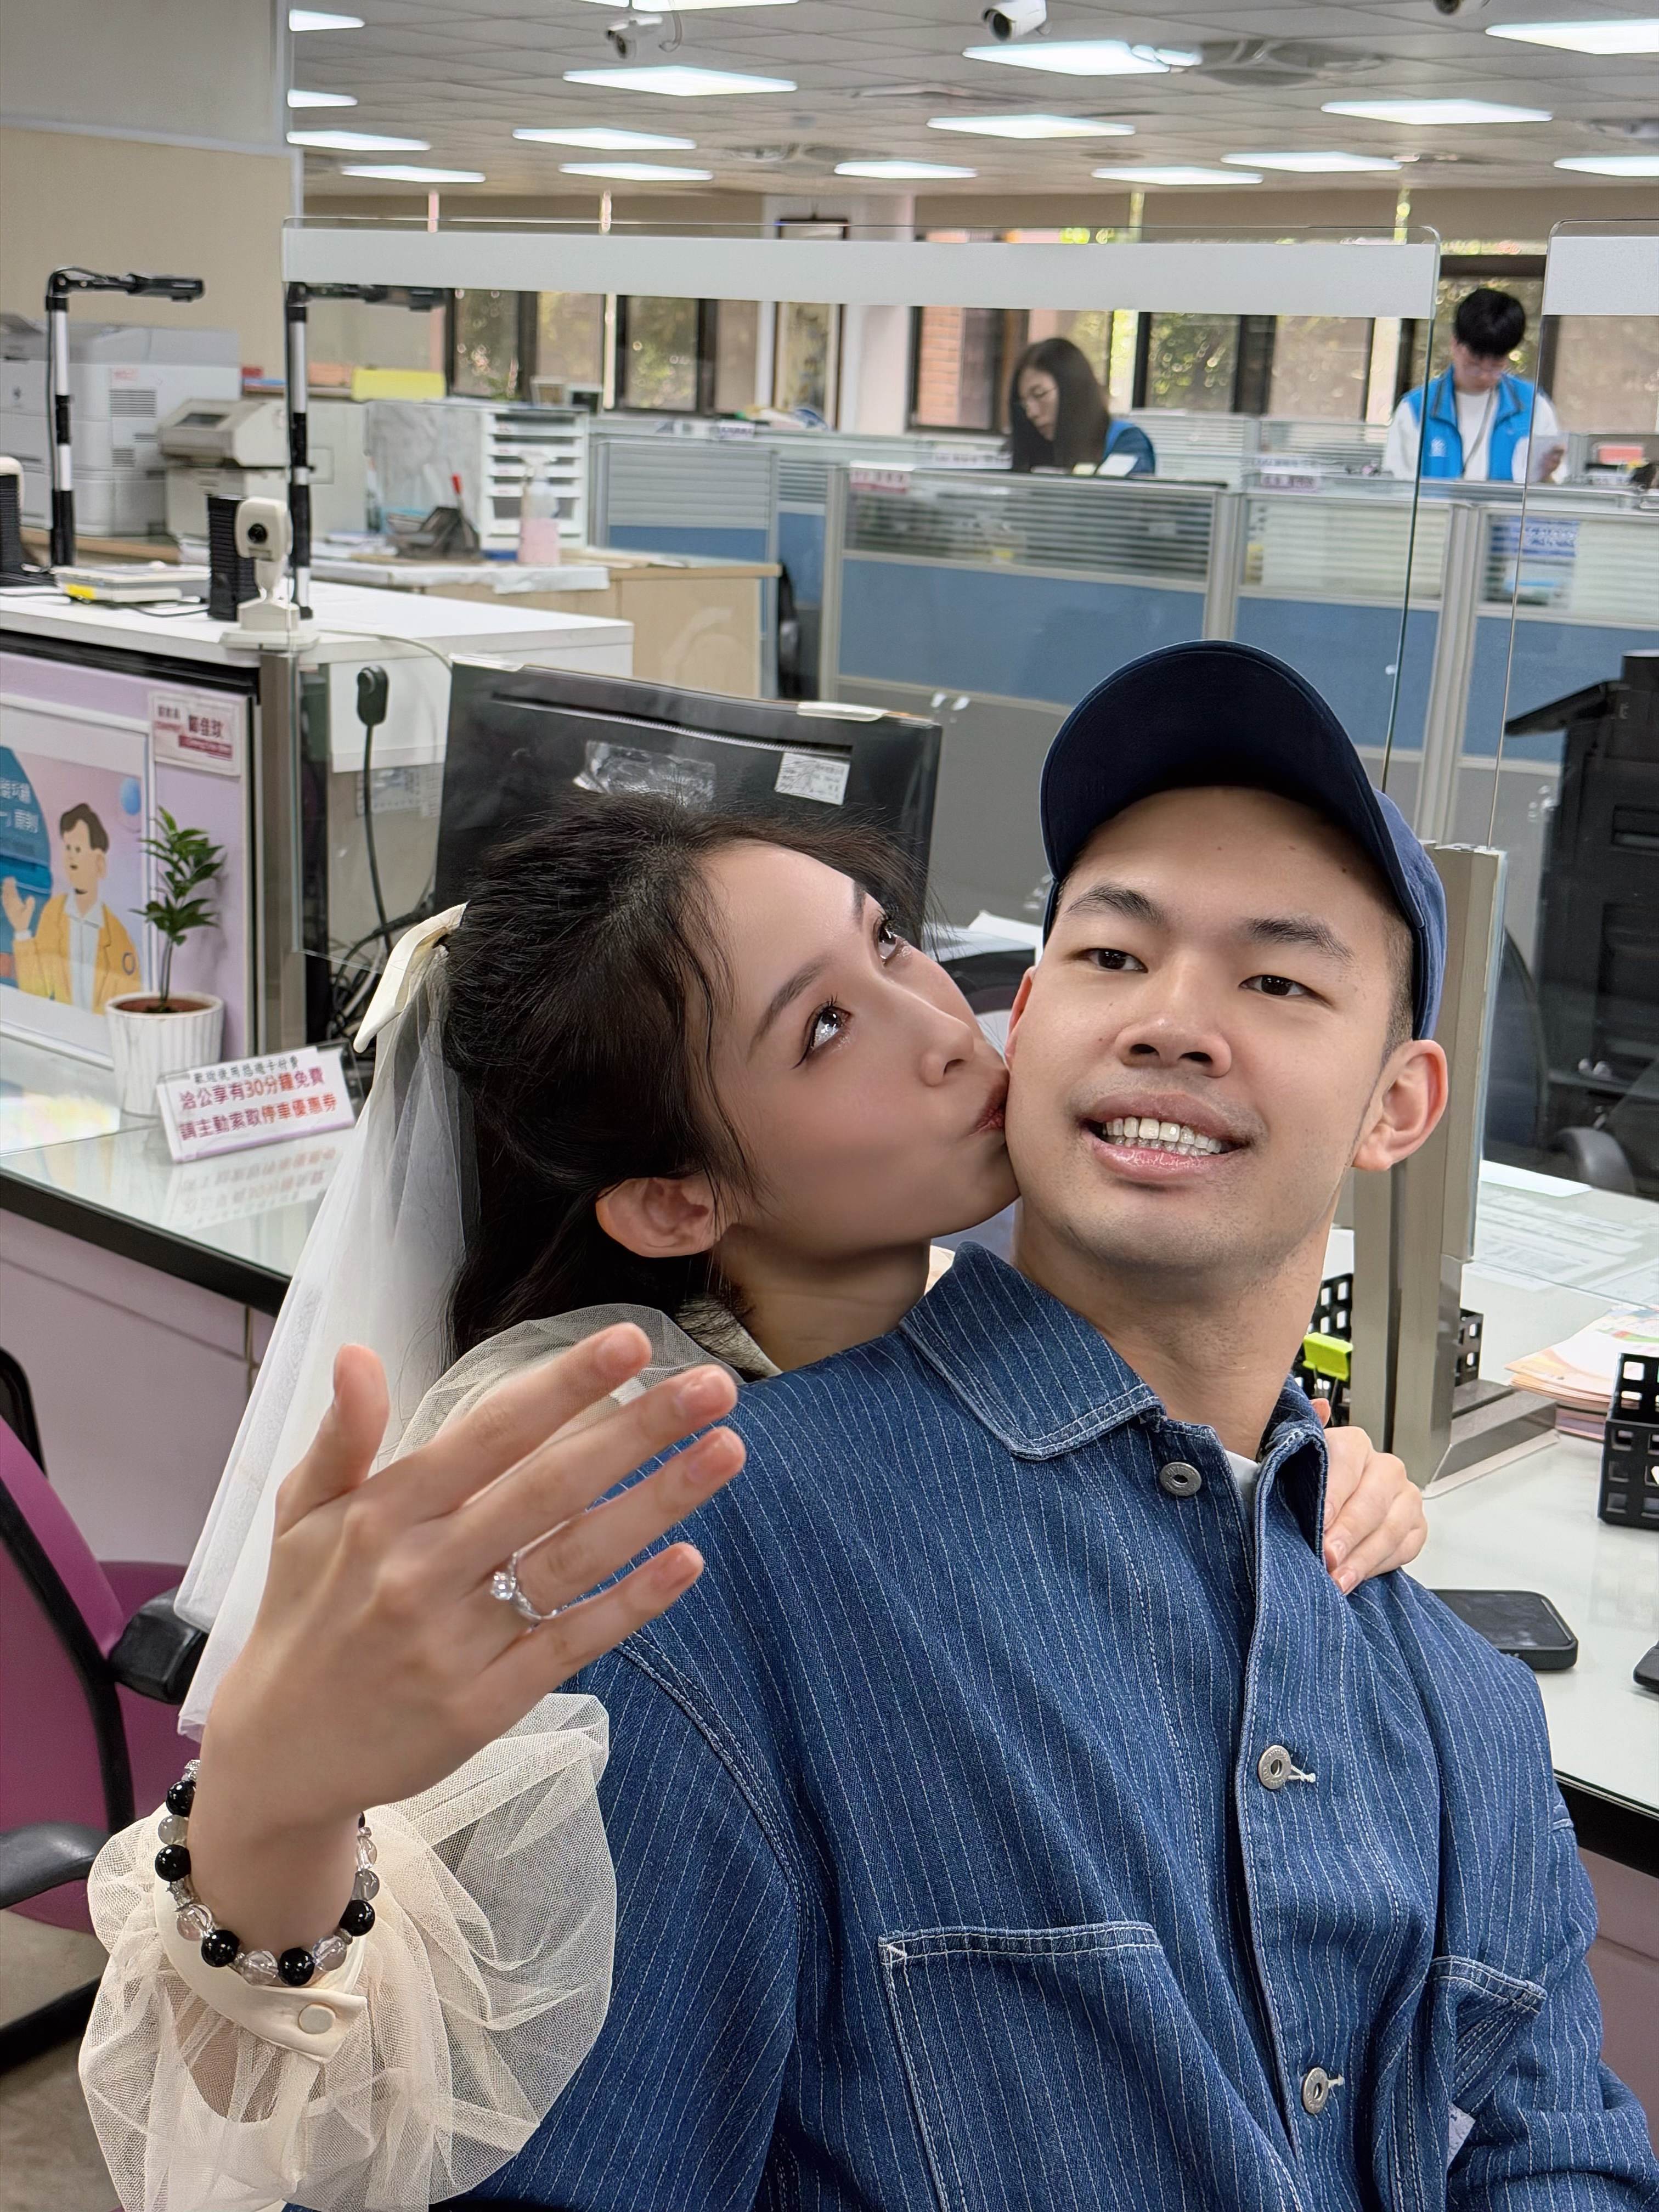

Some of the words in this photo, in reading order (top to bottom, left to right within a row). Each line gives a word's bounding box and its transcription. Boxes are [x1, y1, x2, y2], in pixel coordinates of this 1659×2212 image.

[179, 1066, 325, 1110] 洽公享有30分鐘免費
